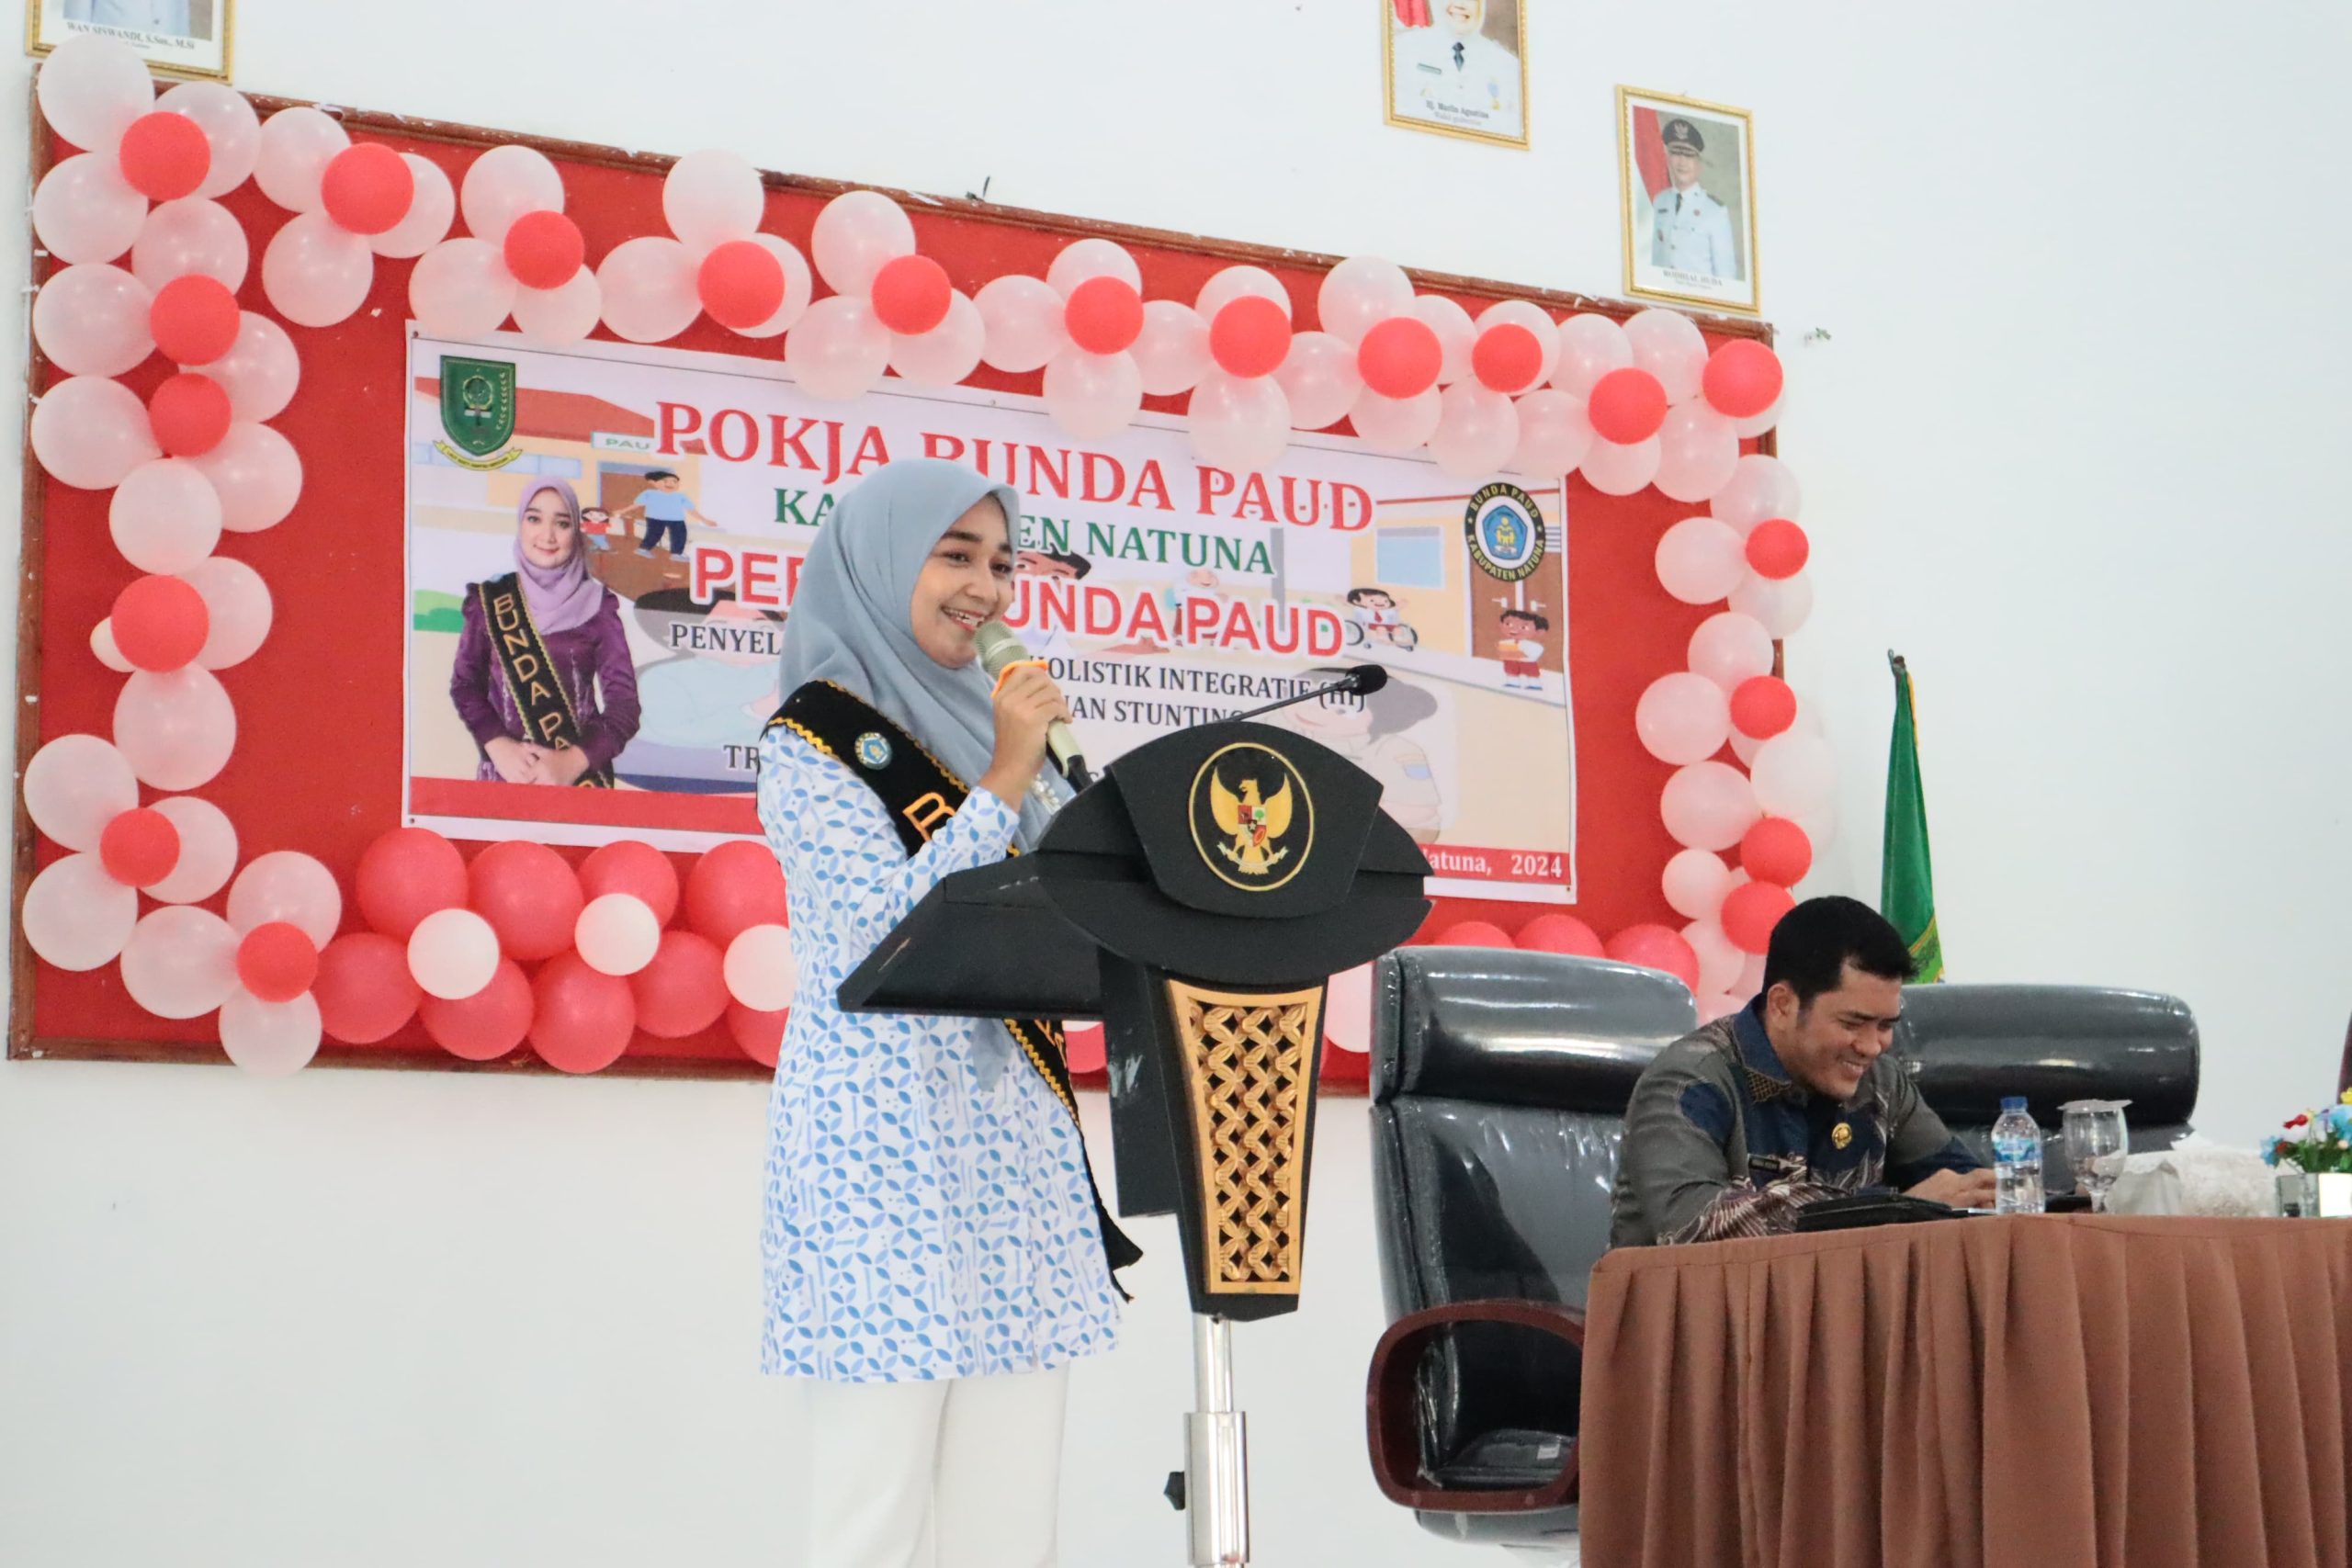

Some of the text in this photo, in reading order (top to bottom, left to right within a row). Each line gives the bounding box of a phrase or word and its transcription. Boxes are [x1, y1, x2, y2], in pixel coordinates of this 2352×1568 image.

[656, 400, 890, 486] POKJA
[1195, 465, 1373, 532] PAUD
[1470, 483, 1539, 519] BUNDA PAUD
[1087, 521, 1275, 575] NATUNA
[1466, 534, 1544, 581] KABUPATEN NATUNA
[1000, 578, 1169, 643] UNDA
[1186, 596, 1343, 658] PAUD
[492, 592, 551, 706] BUNDA
[670, 623, 781, 656] PENYEL
[1029, 654, 1153, 689] OLISTIK
[1114, 699, 1245, 728] STUNTIN
[1422, 848, 1563, 878] atuna, 2024
